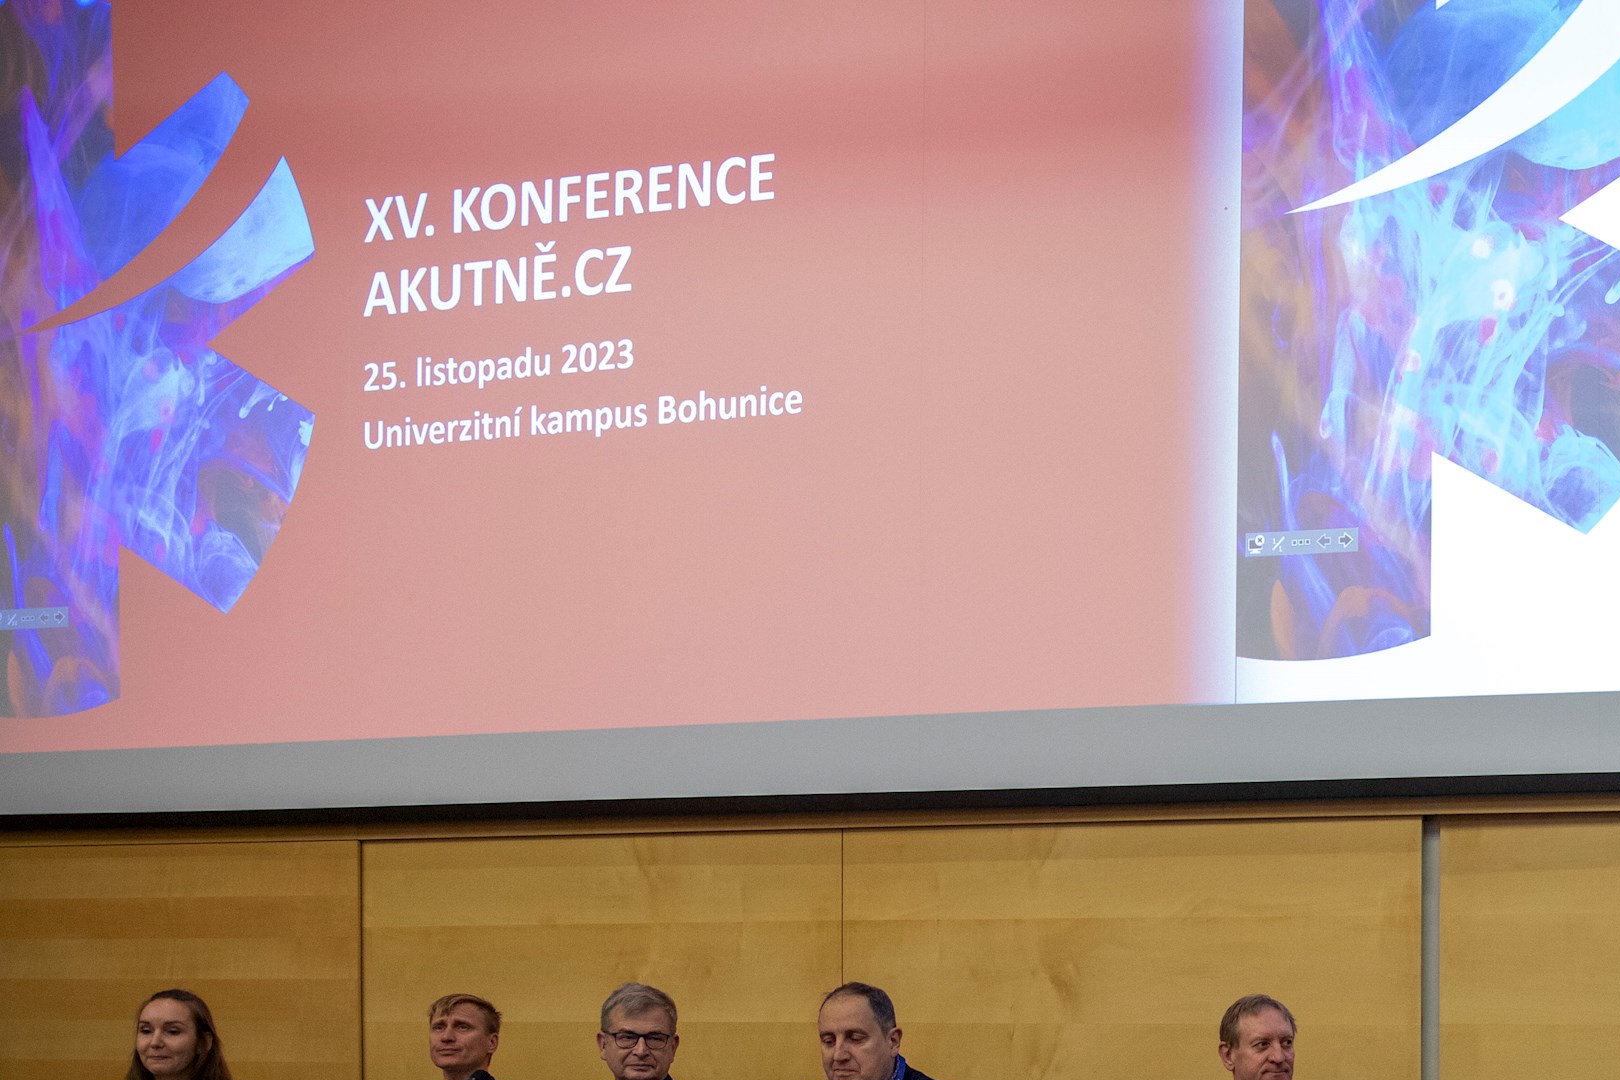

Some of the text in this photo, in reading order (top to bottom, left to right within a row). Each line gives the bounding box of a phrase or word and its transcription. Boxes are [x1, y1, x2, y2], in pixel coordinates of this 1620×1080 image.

[364, 153, 776, 244] XV. KONFERENCE
[363, 241, 633, 318] AKUTNĚ.CZ
[363, 338, 636, 392] 25. listopadu 2023
[363, 385, 804, 450] Univerzitní kampus Bohunice
